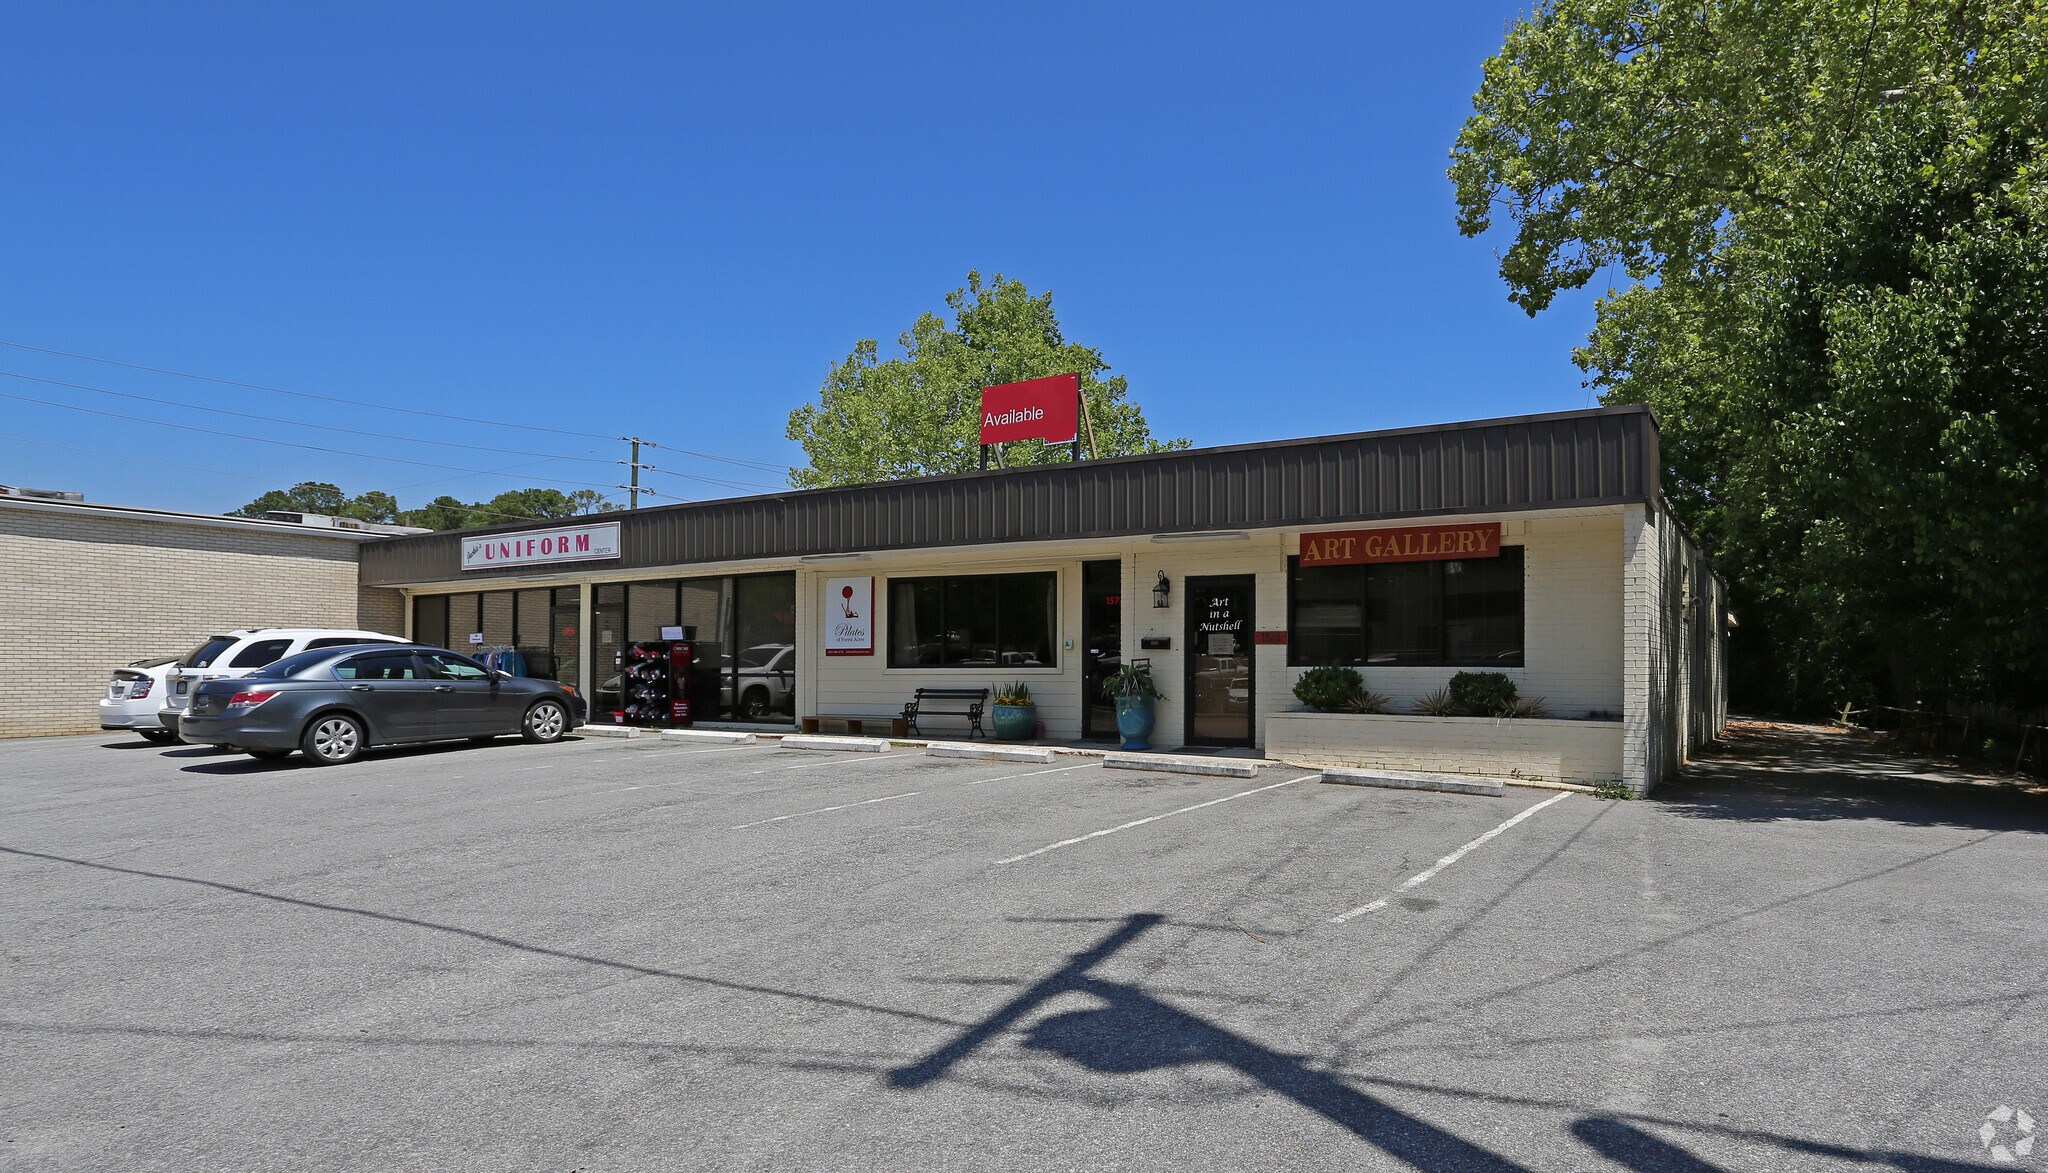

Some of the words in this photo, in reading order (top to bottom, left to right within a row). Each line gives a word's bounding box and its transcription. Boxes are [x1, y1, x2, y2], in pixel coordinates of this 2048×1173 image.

[983, 406, 1044, 428] Available
[485, 534, 590, 560] UNIFORM
[594, 546, 612, 555] CENTER
[1303, 537, 1357, 561] ART
[1365, 529, 1495, 558] GALLERY
[1209, 597, 1230, 608] Art
[1209, 610, 1220, 619] in
[1223, 610, 1230, 618] a
[834, 622, 865, 637] Pilates
[1199, 619, 1243, 632] Nutshell
